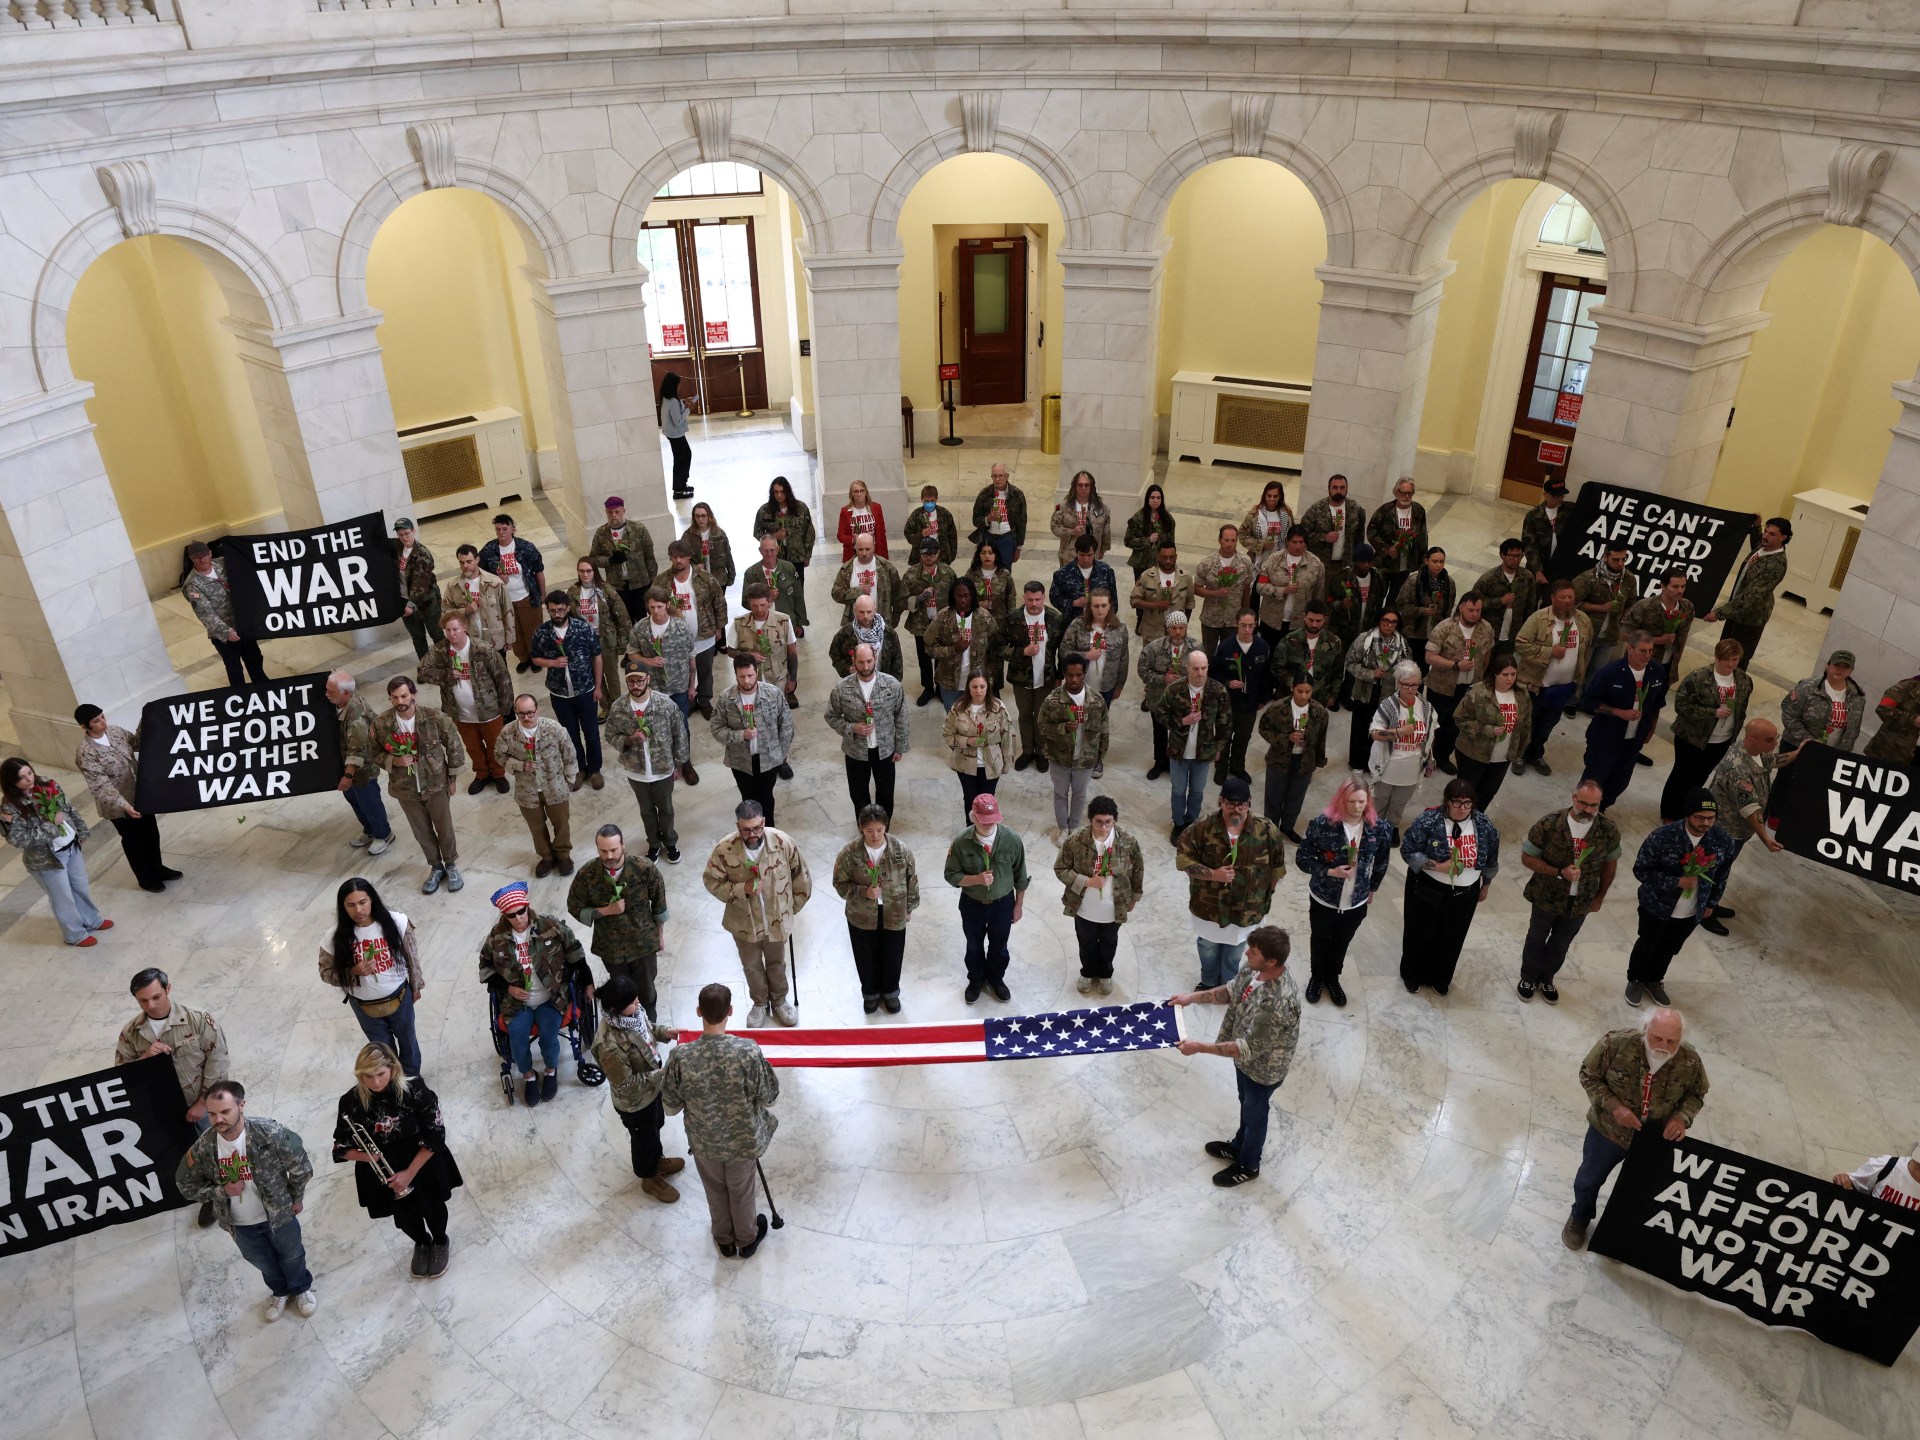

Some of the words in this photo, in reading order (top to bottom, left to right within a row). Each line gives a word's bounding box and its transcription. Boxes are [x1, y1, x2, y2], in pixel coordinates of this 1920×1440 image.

[1586, 514, 1712, 561] AFFORD
[1599, 491, 1638, 518] WE
[1643, 503, 1725, 538] CAN'T
[252, 538, 306, 564] END
[312, 526, 364, 555] THE
[255, 555, 375, 608] WAR
[265, 609, 306, 632] ON
[312, 597, 379, 628] IRAN
[168, 699, 217, 726] WE
[224, 683, 313, 718] CAN'T
[169, 710, 316, 755] AFFORD
[167, 740, 319, 779] ANOTHER
[1831, 758, 1911, 798] END
[197, 770, 291, 803] WAR
[1827, 788, 1920, 853] WA
[1816, 837, 1873, 871] ON
[1886, 857, 1920, 886] IR
[22, 1077, 131, 1129] THE
[0, 1118, 155, 1208] AR
[0, 1212, 29, 1246] N
[38, 1171, 164, 1231] IRAN
[1672, 1148, 1746, 1191] WE
[1755, 1178, 1917, 1250] CAN'T
[1653, 1180, 1891, 1278] AFFORD
[1643, 1208, 1877, 1310] ANOTHER
[1680, 1244, 1815, 1318] WAR
